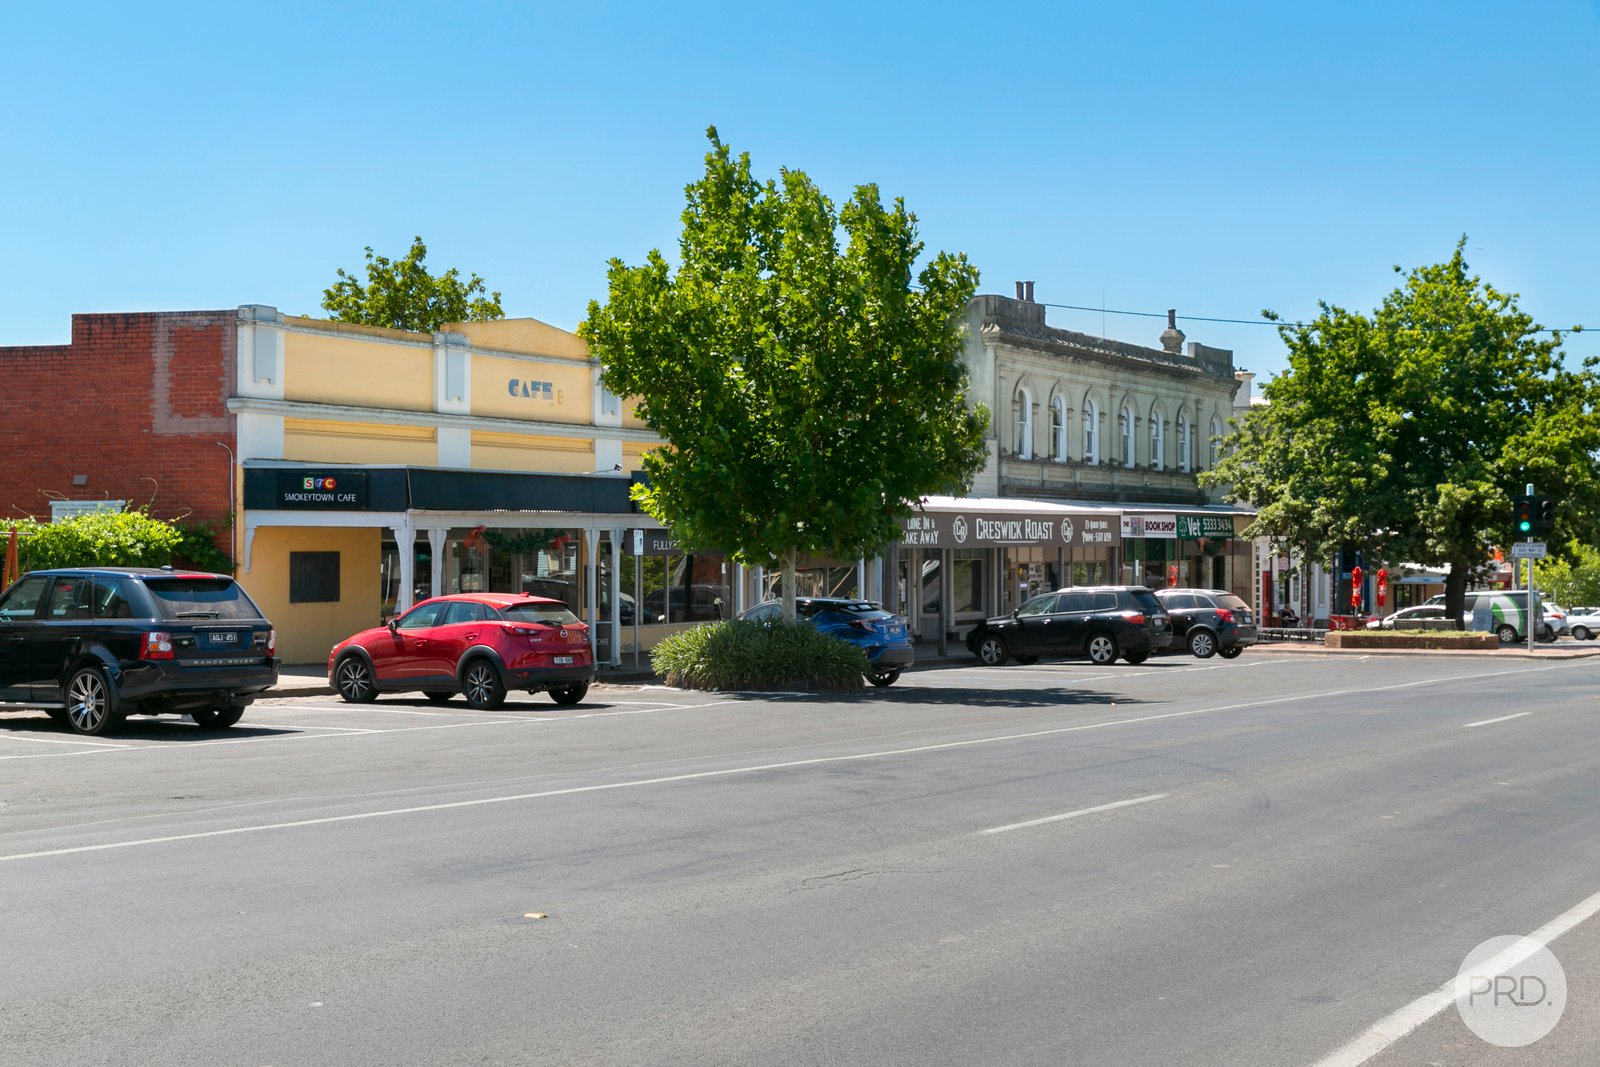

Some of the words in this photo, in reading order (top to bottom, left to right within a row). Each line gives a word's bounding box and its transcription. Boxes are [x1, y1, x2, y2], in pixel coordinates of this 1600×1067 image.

[508, 378, 553, 400] CAFE
[284, 493, 334, 501] SMOKEYTOWN
[337, 493, 356, 502] CAFE
[976, 518, 1022, 540] CRESWICK
[1025, 519, 1054, 540] ROAST
[1187, 517, 1201, 536] Vet
[1202, 518, 1217, 530] 5333
[653, 540, 673, 550] FULLY
[919, 530, 939, 544] AWAY
